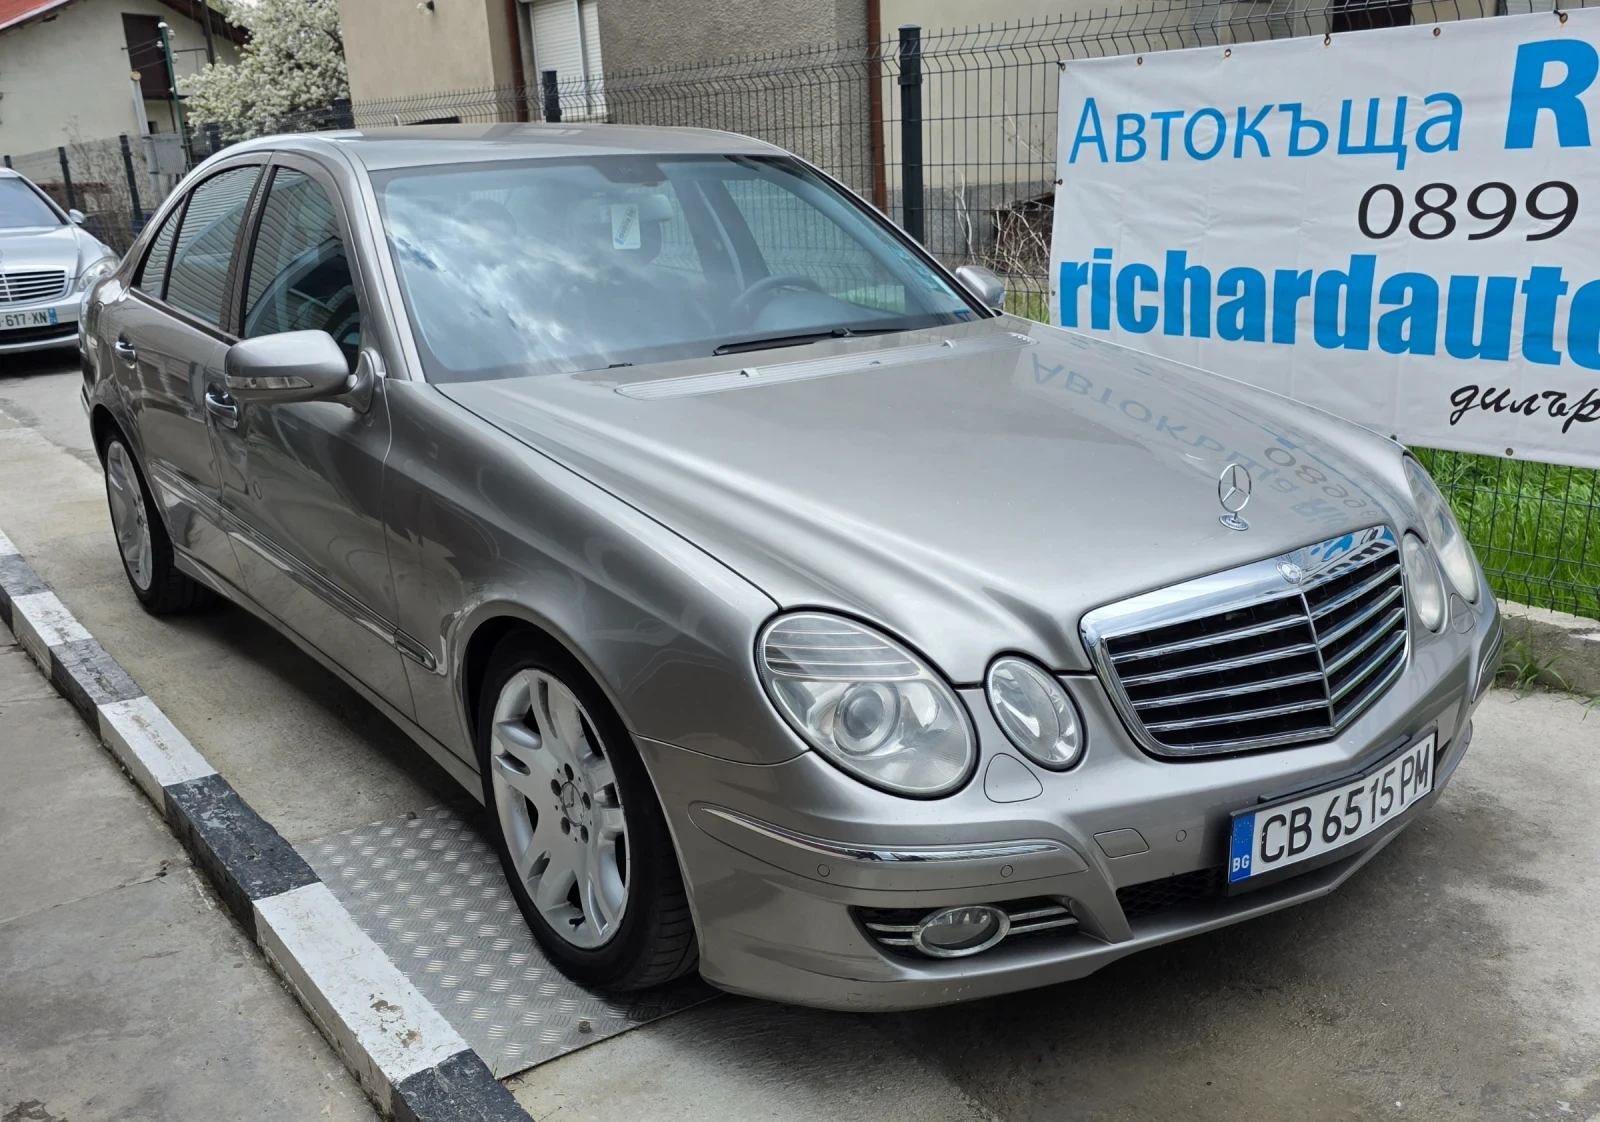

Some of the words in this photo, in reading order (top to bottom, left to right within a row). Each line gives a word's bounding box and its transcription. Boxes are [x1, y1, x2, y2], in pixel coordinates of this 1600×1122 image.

[1069, 92, 1464, 171] Автокъща
[1504, 38, 1600, 150] R
[1357, 181, 1580, 242] 0899
[1260, 806, 1312, 863] CB
[1322, 766, 1396, 843] 6515
[1400, 743, 1430, 806] PM
[1232, 854, 1250, 873] BG
